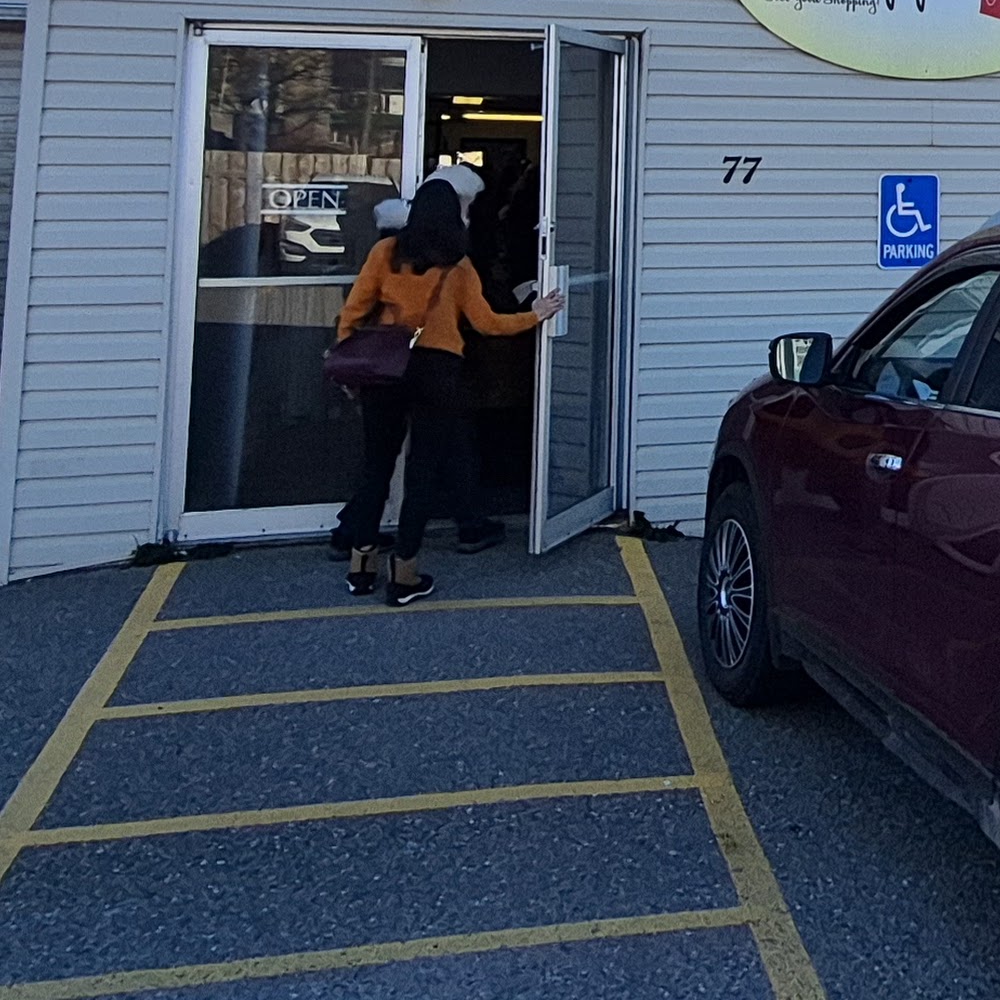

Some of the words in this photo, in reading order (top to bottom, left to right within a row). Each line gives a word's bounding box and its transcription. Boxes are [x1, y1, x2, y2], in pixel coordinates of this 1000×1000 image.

[722, 156, 762, 184] 77
[268, 189, 340, 209] OPEN
[883, 243, 934, 259] PARKING
